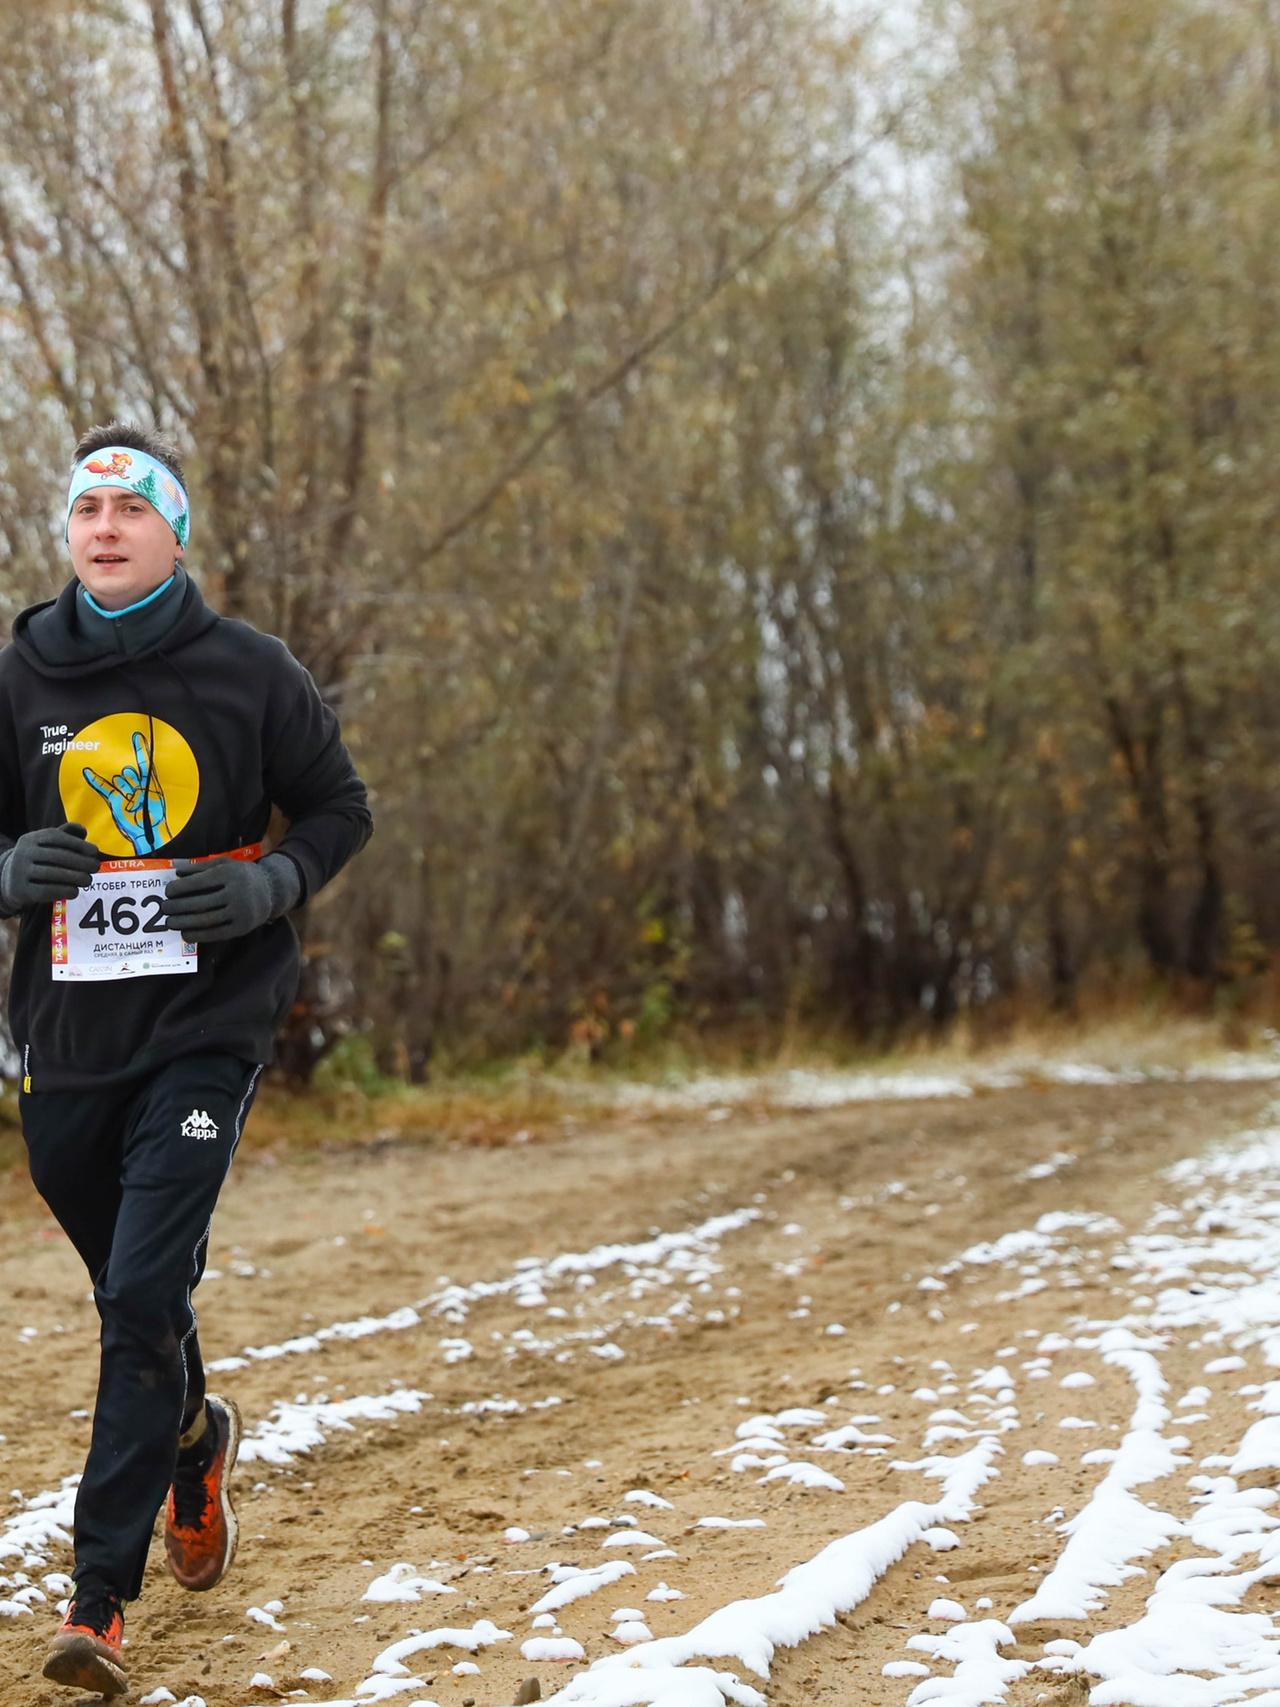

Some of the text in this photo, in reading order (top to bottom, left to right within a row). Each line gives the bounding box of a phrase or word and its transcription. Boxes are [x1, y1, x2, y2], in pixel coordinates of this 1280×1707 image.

[42, 738, 101, 755] Engineer
[109, 859, 145, 869] ULTRA
[130, 879, 161, 889] ТРЕЙЛ
[78, 895, 169, 935] 462
[55, 914, 63, 937] TRAIL
[55, 937, 64, 962] TAIGA
[93, 940, 164, 952] ДИСТАНЦИЯ М
[181, 1125, 217, 1140] Kappa
